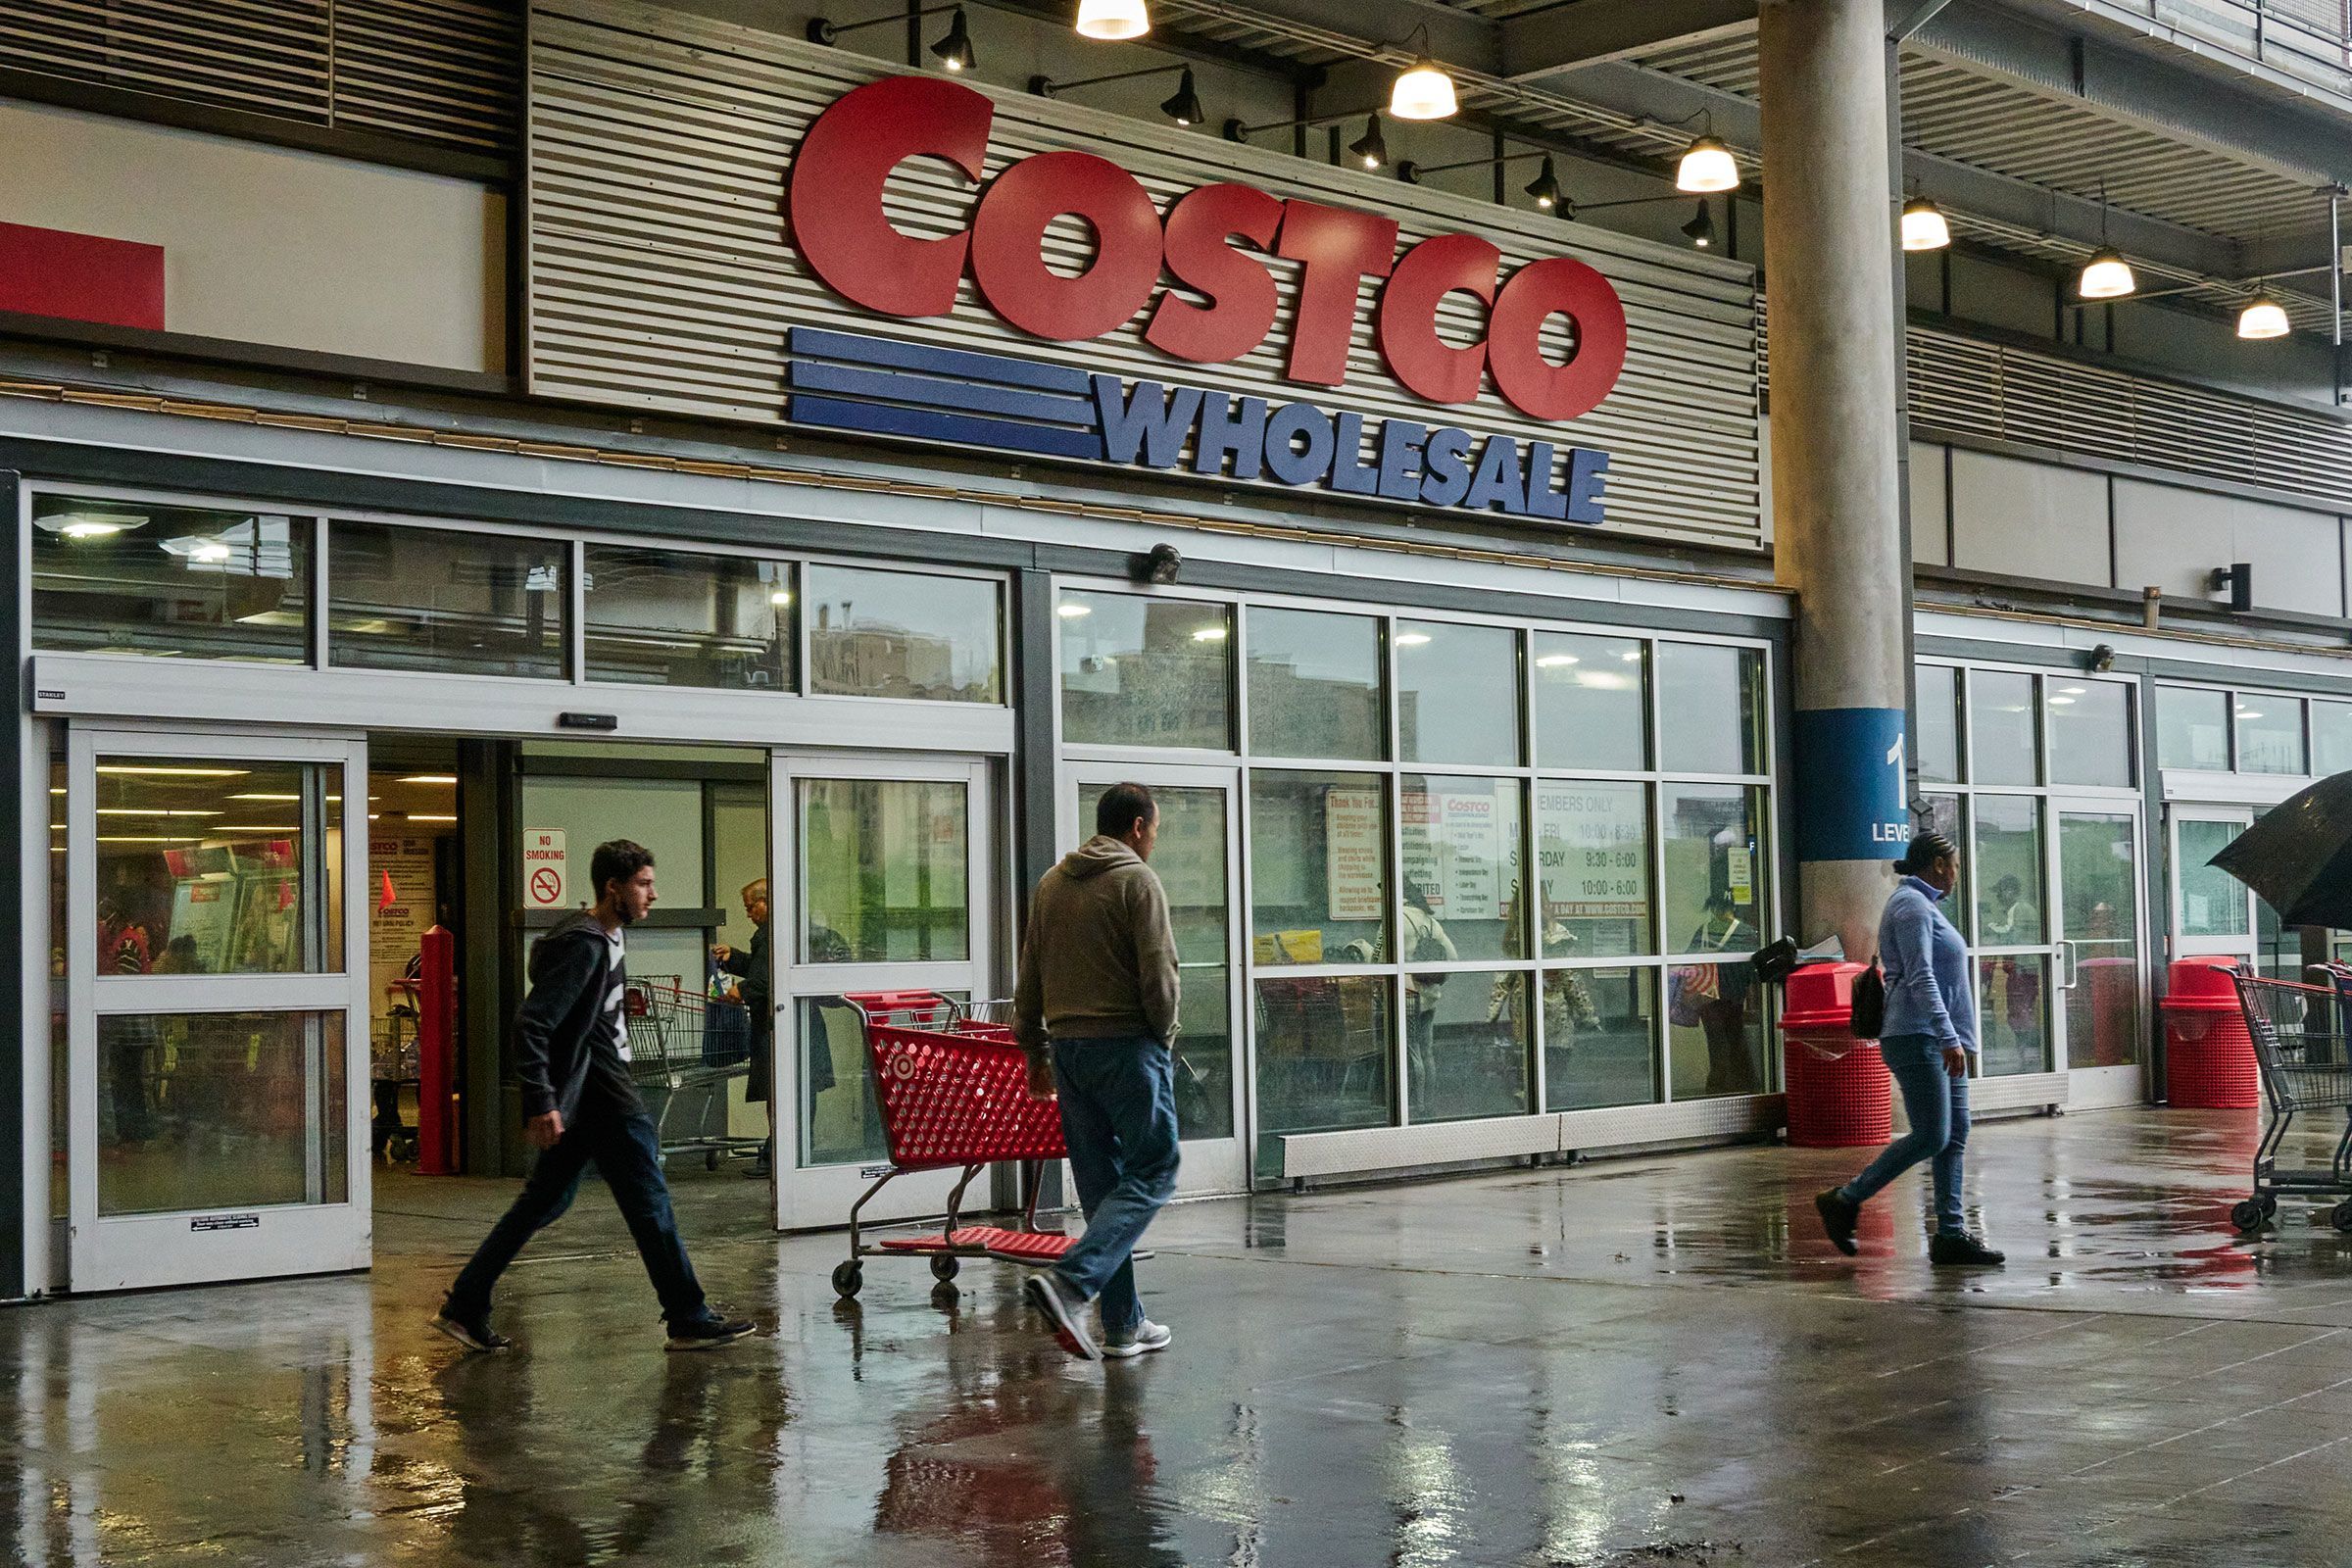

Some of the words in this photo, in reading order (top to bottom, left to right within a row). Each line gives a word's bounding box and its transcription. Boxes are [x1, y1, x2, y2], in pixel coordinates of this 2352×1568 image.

[788, 75, 1627, 421] COSTCO
[1090, 372, 1610, 524] WHOLESALE
[1886, 733, 1907, 809] 1
[1538, 796, 1583, 811] EMBERS
[1587, 797, 1612, 811] ONLY
[1544, 823, 1560, 839] FRI
[1873, 823, 1909, 843] LEVE
[370, 842, 398, 851] STCO
[539, 835, 551, 846] NO
[525, 850, 564, 860] SMOKING
[1586, 852, 1606, 867] 9:30
[1616, 853, 1636, 867] 6:00
[1582, 880, 1607, 895] 10:00
[1617, 880, 1637, 896] 6:00
